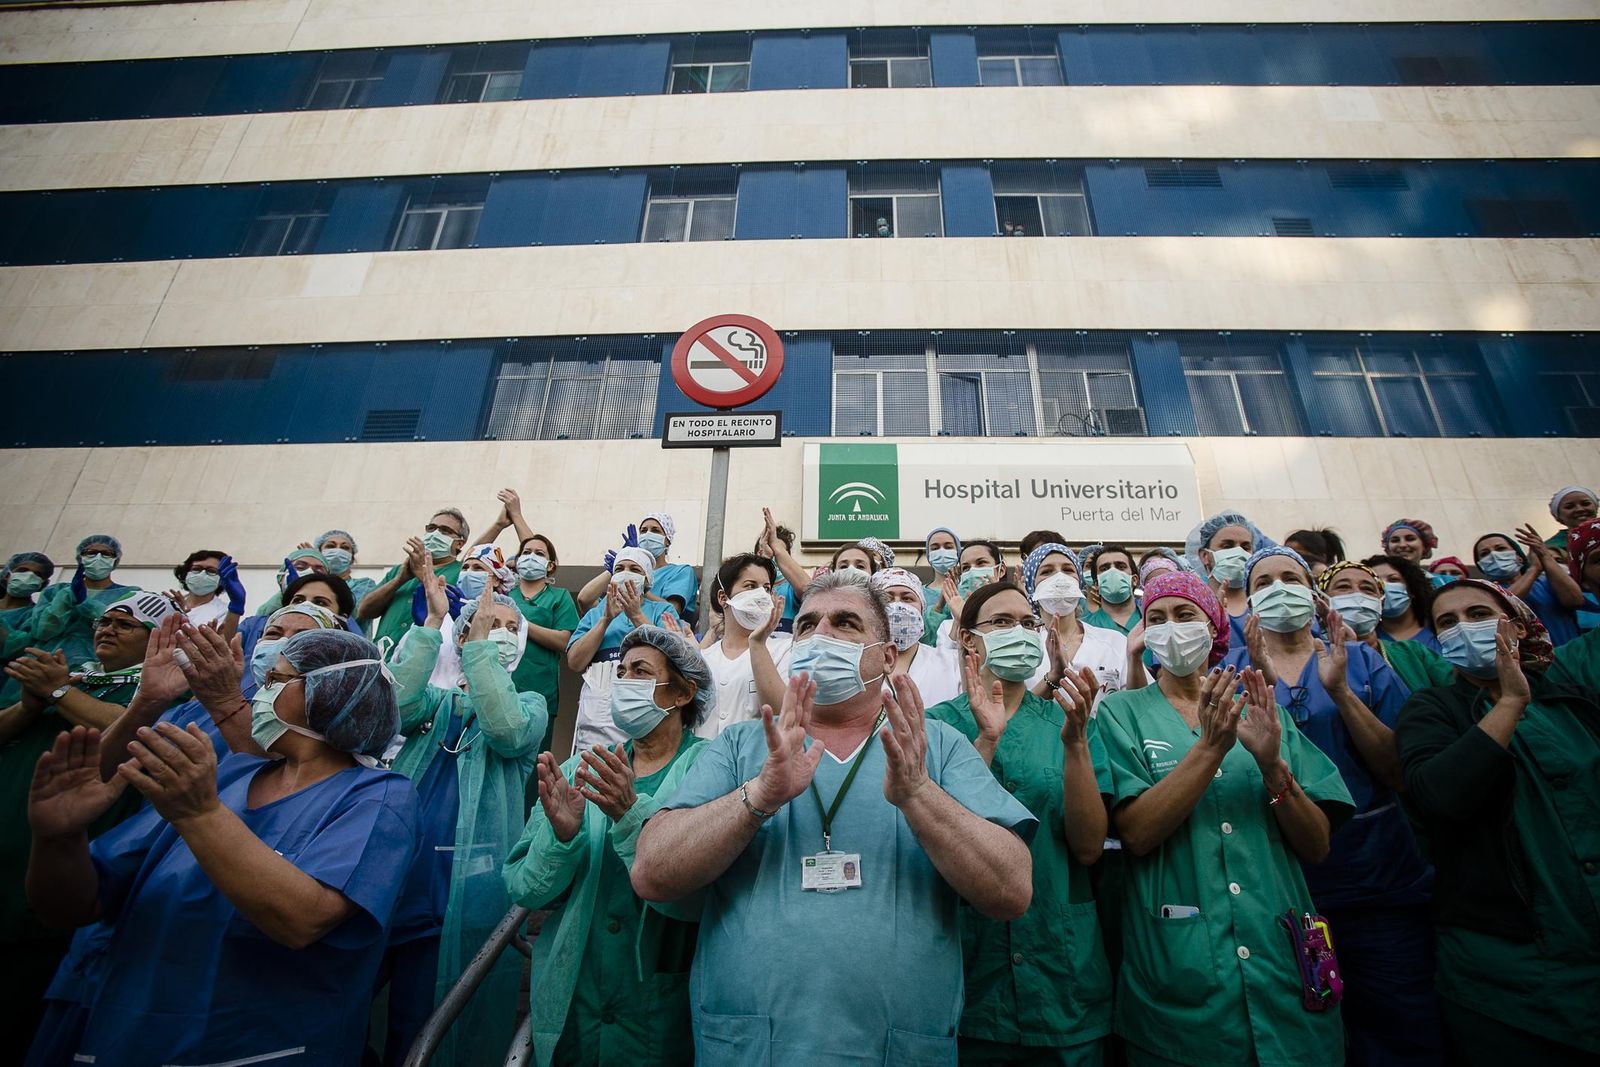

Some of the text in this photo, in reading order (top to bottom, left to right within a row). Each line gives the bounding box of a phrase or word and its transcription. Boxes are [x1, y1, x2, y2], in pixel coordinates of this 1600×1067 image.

[672, 420, 685, 428] EN
[731, 418, 772, 426] RECINTO
[687, 428, 756, 437] HOSPITALARIO
[924, 479, 1178, 504] Hospital Universitario
[1061, 506, 1181, 521] Puerta del Mar
